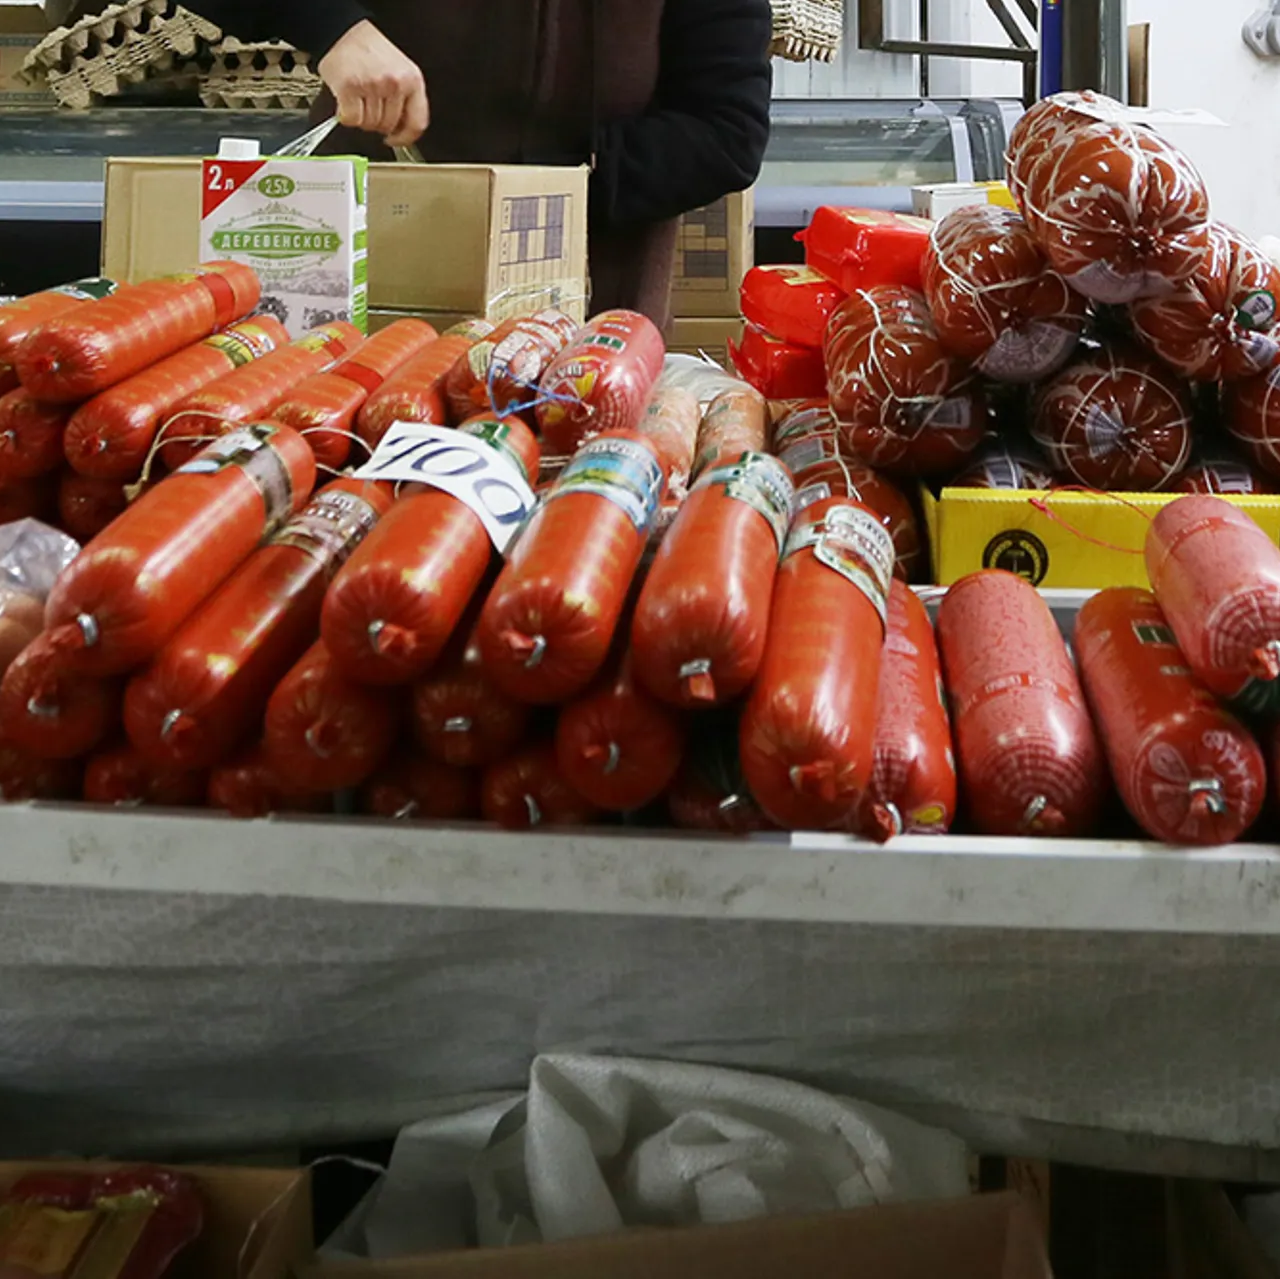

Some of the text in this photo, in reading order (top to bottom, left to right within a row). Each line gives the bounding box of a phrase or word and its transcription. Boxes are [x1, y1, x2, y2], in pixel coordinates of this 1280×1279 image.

[208, 165, 234, 190] 2 л
[221, 234, 332, 249] ДЕРЕВЕНСКОЕ
